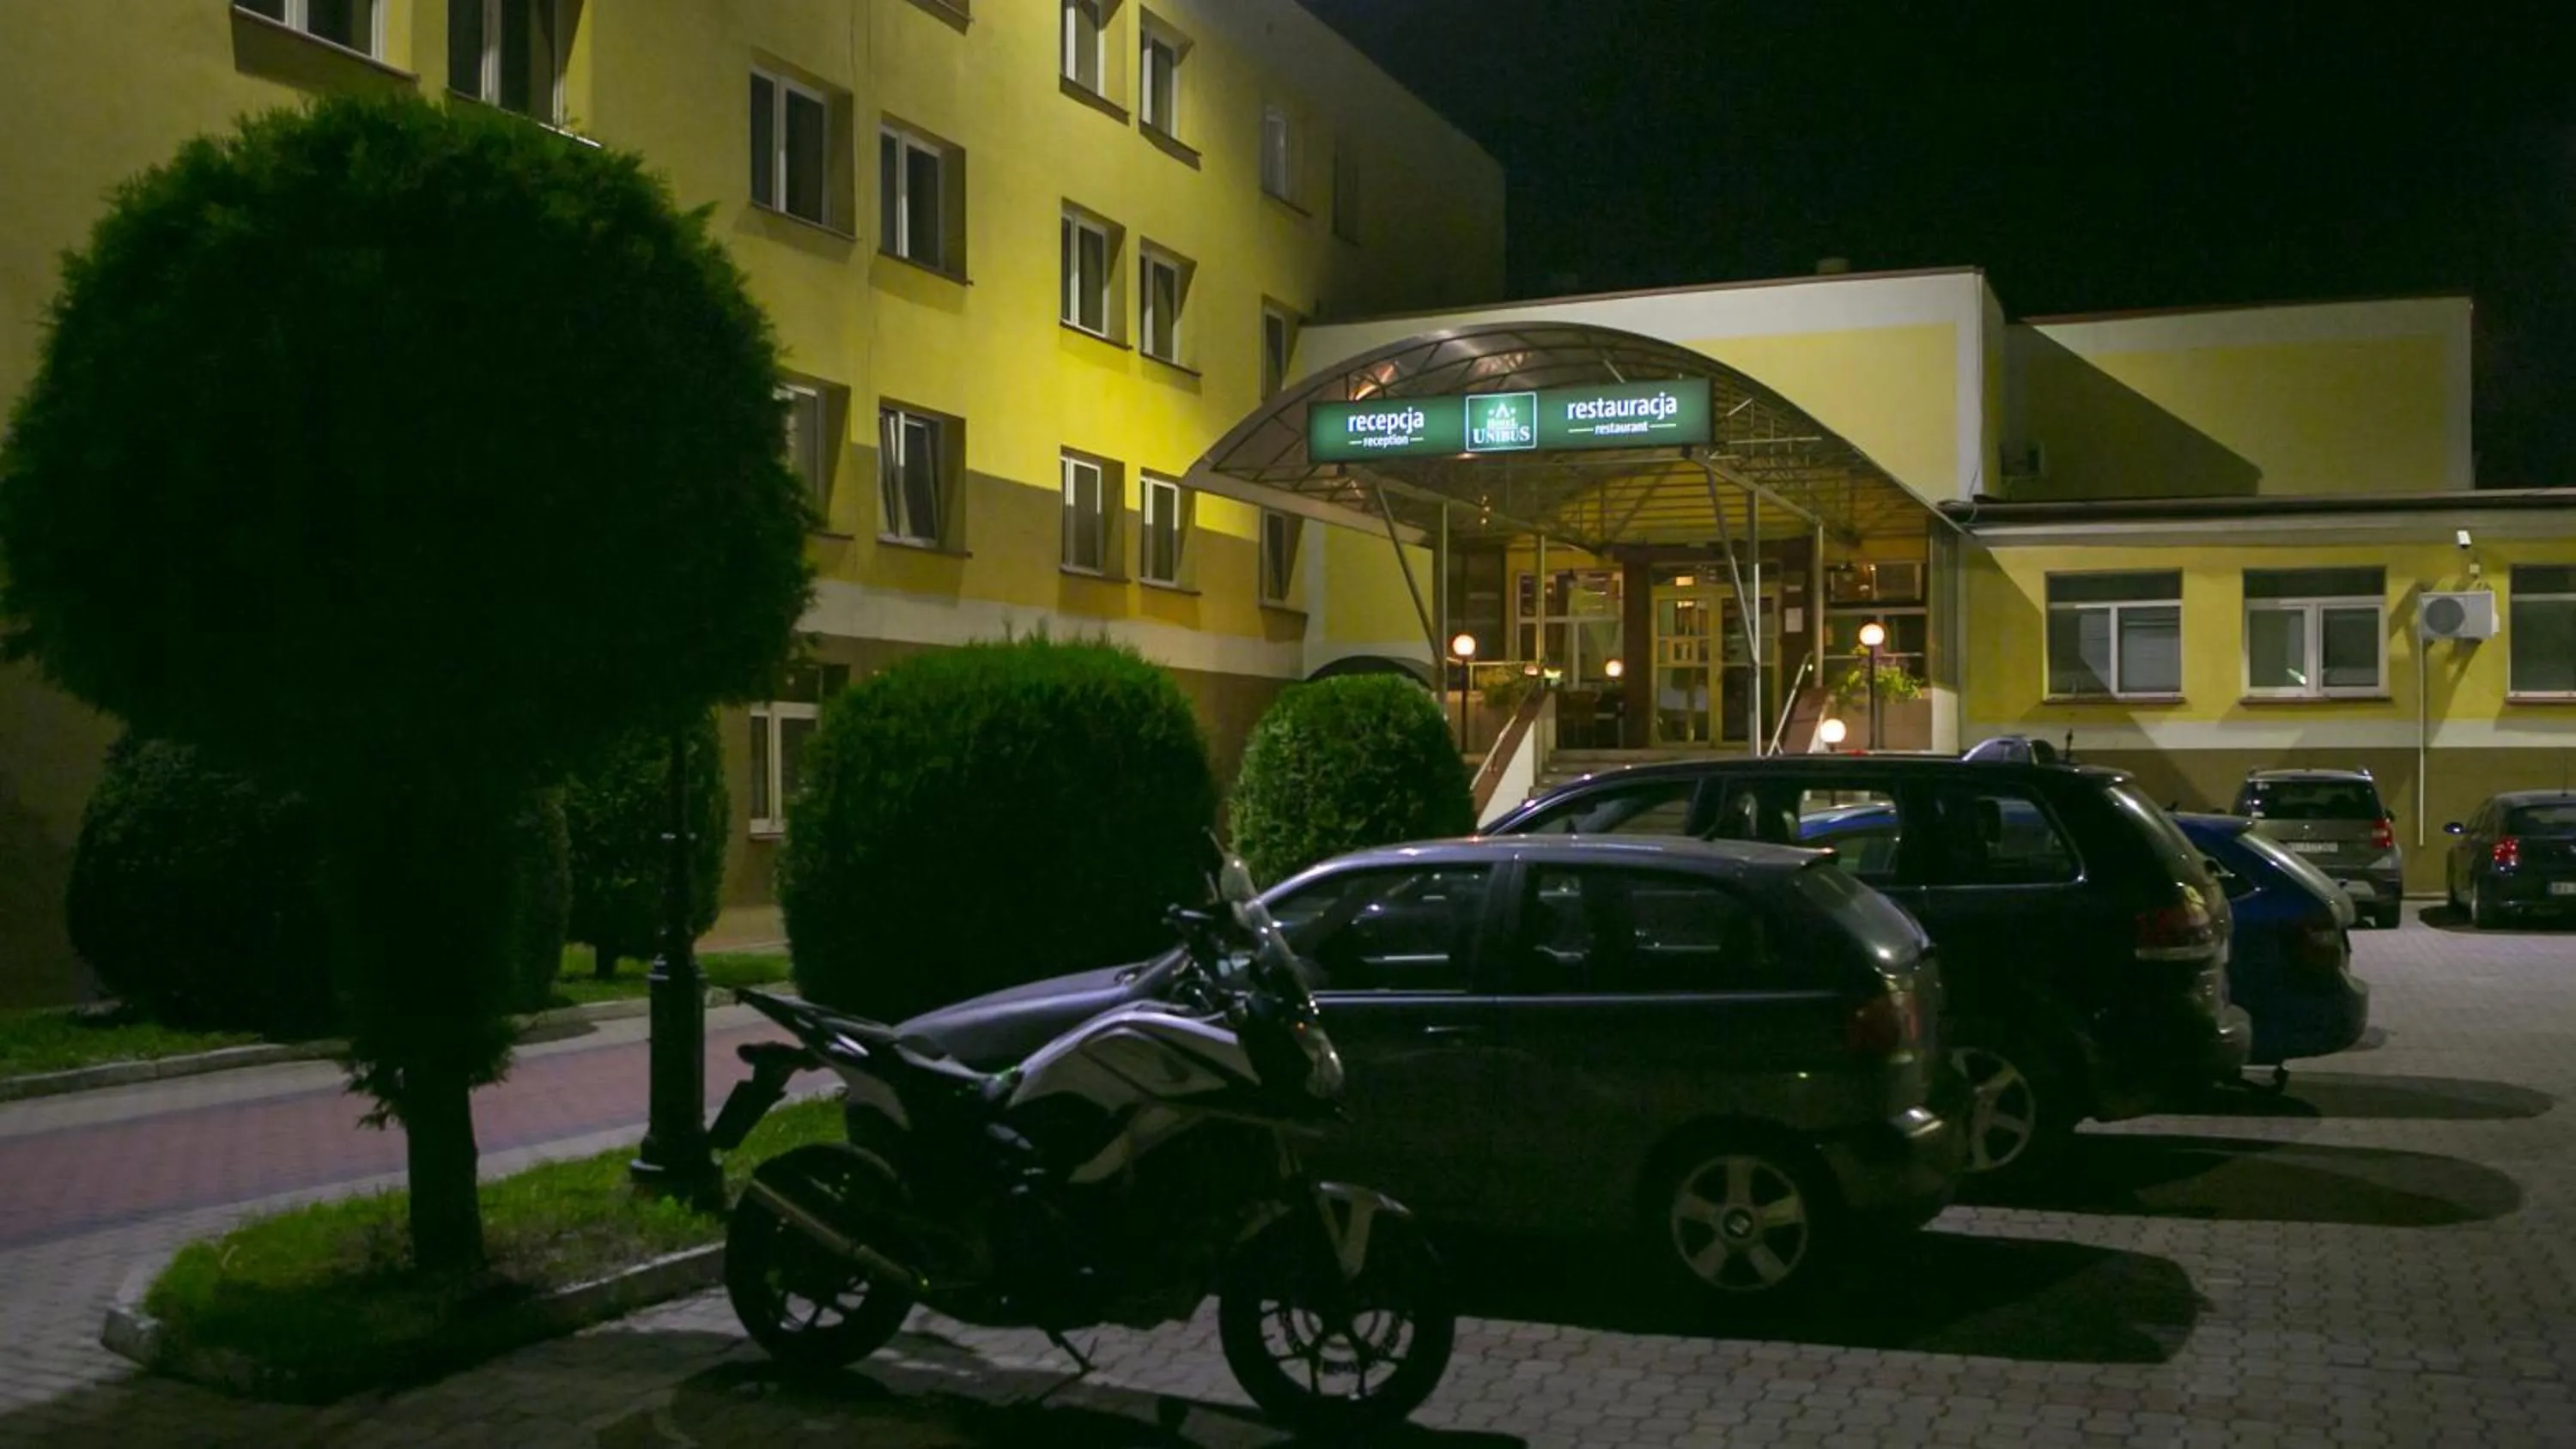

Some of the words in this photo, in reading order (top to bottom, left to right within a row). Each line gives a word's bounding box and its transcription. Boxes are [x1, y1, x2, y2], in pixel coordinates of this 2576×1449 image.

[1567, 391, 1677, 420] restauracja
[1347, 406, 1425, 434] recepcja
[1595, 421, 1648, 434] restaurant
[1363, 434, 1409, 448] reception
[1473, 426, 1530, 443] UNIBUS
